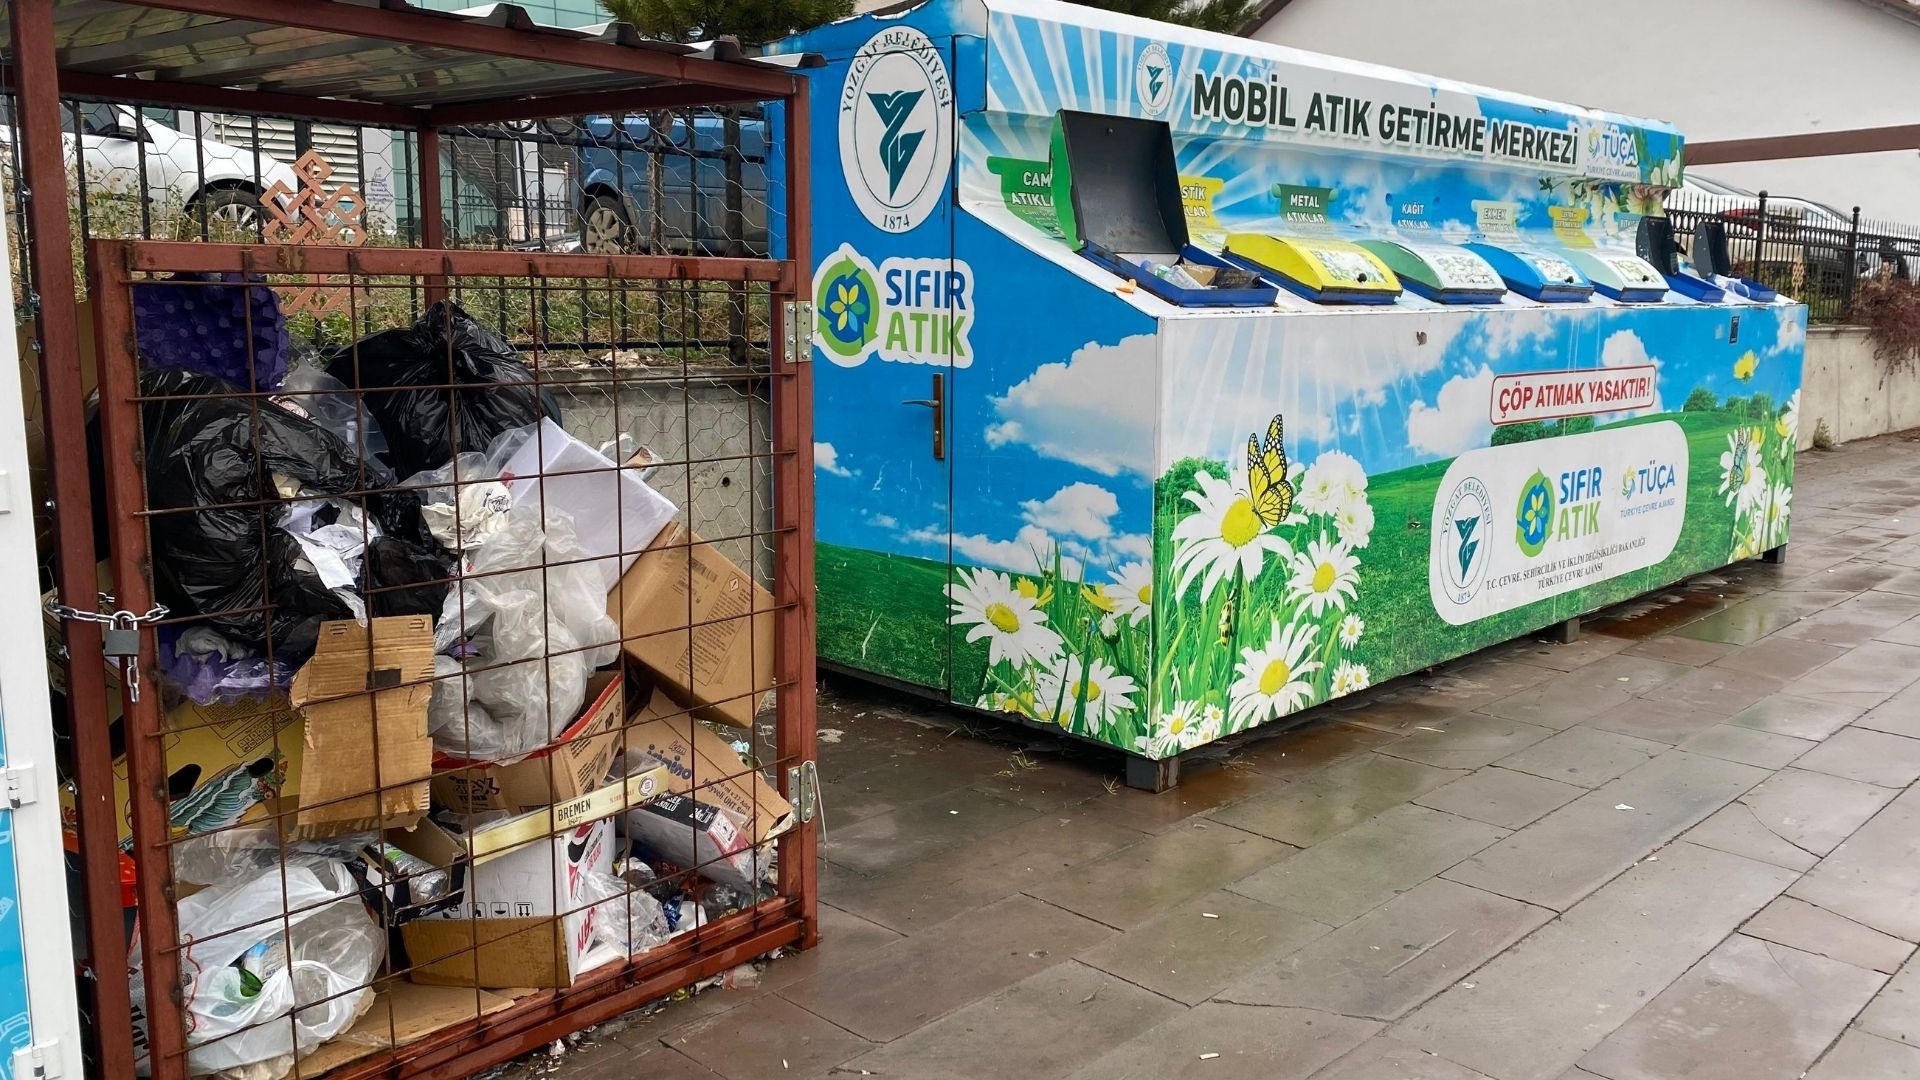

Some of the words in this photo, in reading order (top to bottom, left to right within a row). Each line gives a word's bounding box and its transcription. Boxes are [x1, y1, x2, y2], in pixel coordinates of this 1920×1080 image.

[841, 38, 879, 113] YOZGAT
[1193, 73, 1296, 127] MOBİL
[1304, 92, 1371, 137] ATIK
[1379, 102, 1485, 153] GETİRME
[1490, 121, 1578, 165] MERKEZİ
[1602, 128, 1637, 164] TÜÇA
[1023, 171, 1052, 188] CAM
[1286, 211, 1327, 224] ATIKLAR
[1290, 194, 1320, 208] METAL
[1401, 201, 1425, 215] KAĞIT
[882, 213, 910, 230] 1874
[885, 269, 966, 310] SIFIR
[885, 311, 966, 356] ATIK
[1499, 381, 1533, 418] ÇÖP
[1535, 382, 1586, 408] ATMAK
[1588, 377, 1651, 403] YASAKTIR!
[1559, 467, 1602, 504] SIFIR
[1638, 460, 1676, 495] TÜÇA
[1557, 501, 1601, 542] ATIK
[557, 798, 591, 822] BREMEN
[722, 795, 737, 809] UHT
